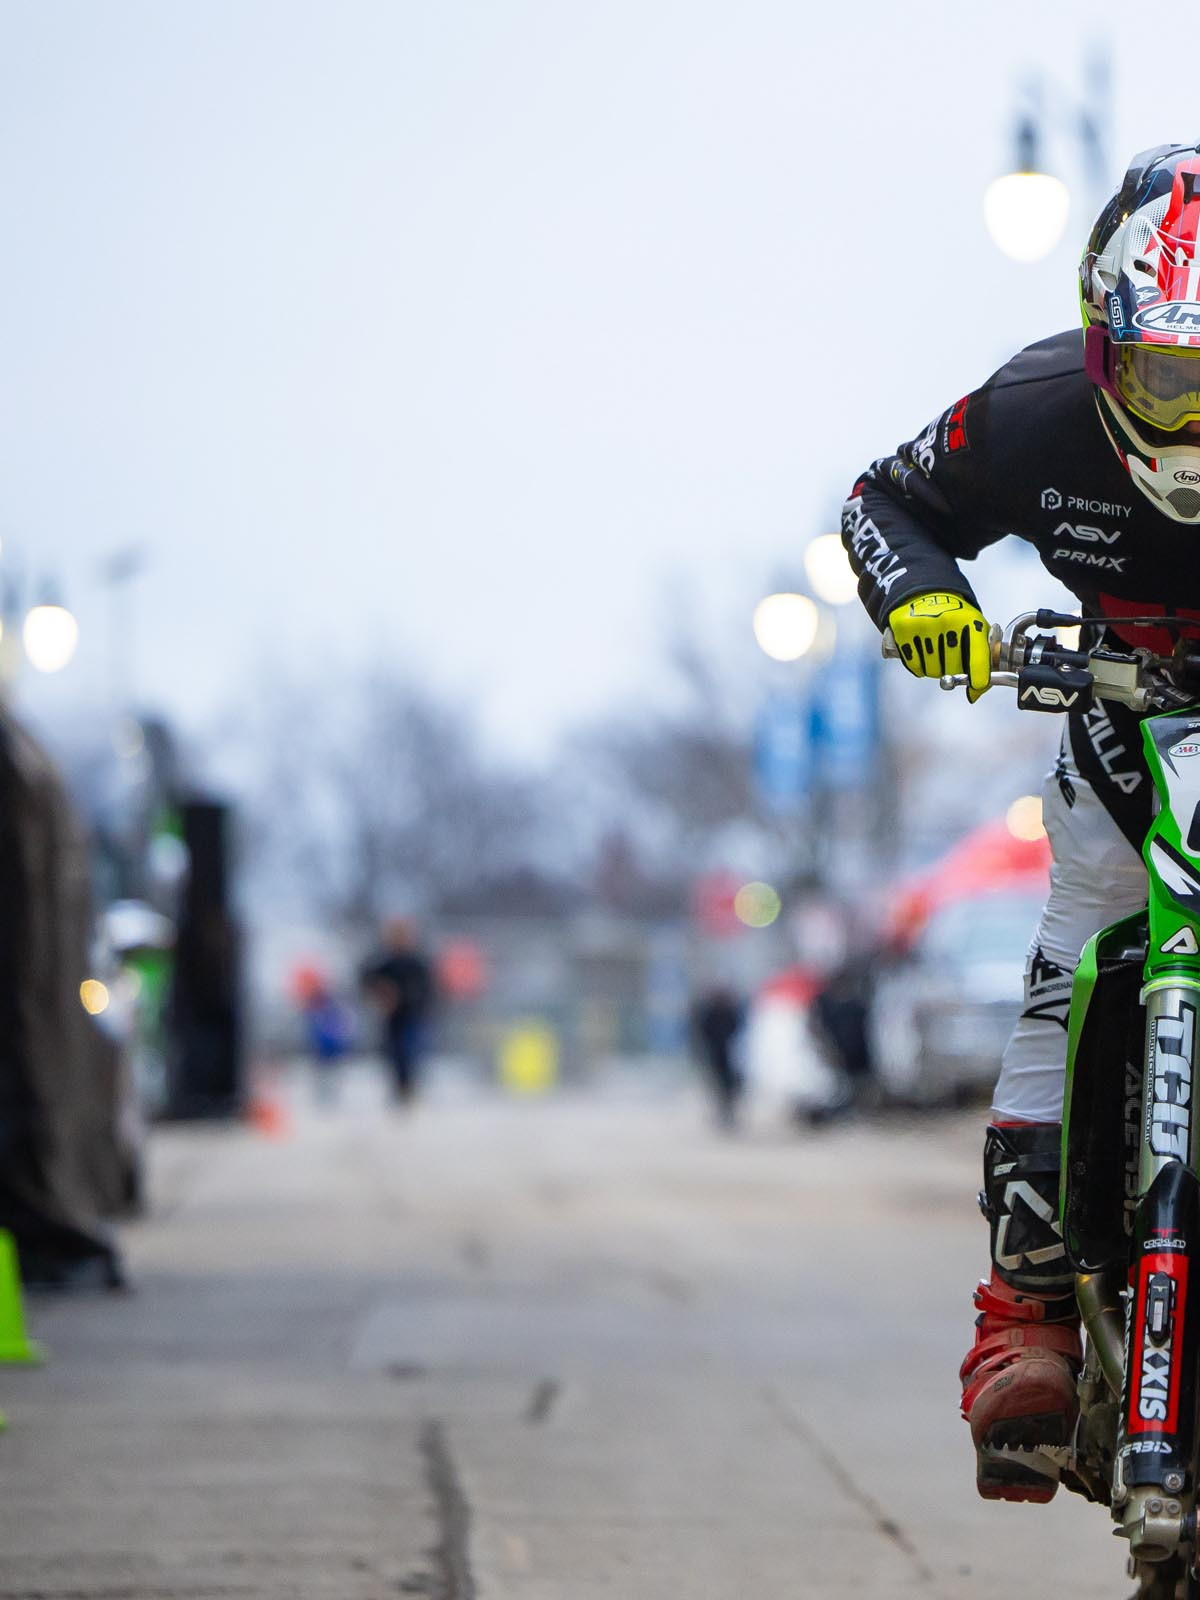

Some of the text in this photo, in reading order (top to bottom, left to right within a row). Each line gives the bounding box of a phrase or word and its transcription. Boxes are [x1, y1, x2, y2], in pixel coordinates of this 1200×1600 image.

[1178, 471, 1199, 482] Arai
[1067, 495, 1133, 518] PRIORITY
[1053, 521, 1122, 544] ASV
[1052, 548, 1128, 573] PRMX
[1020, 685, 1079, 707] ASV
